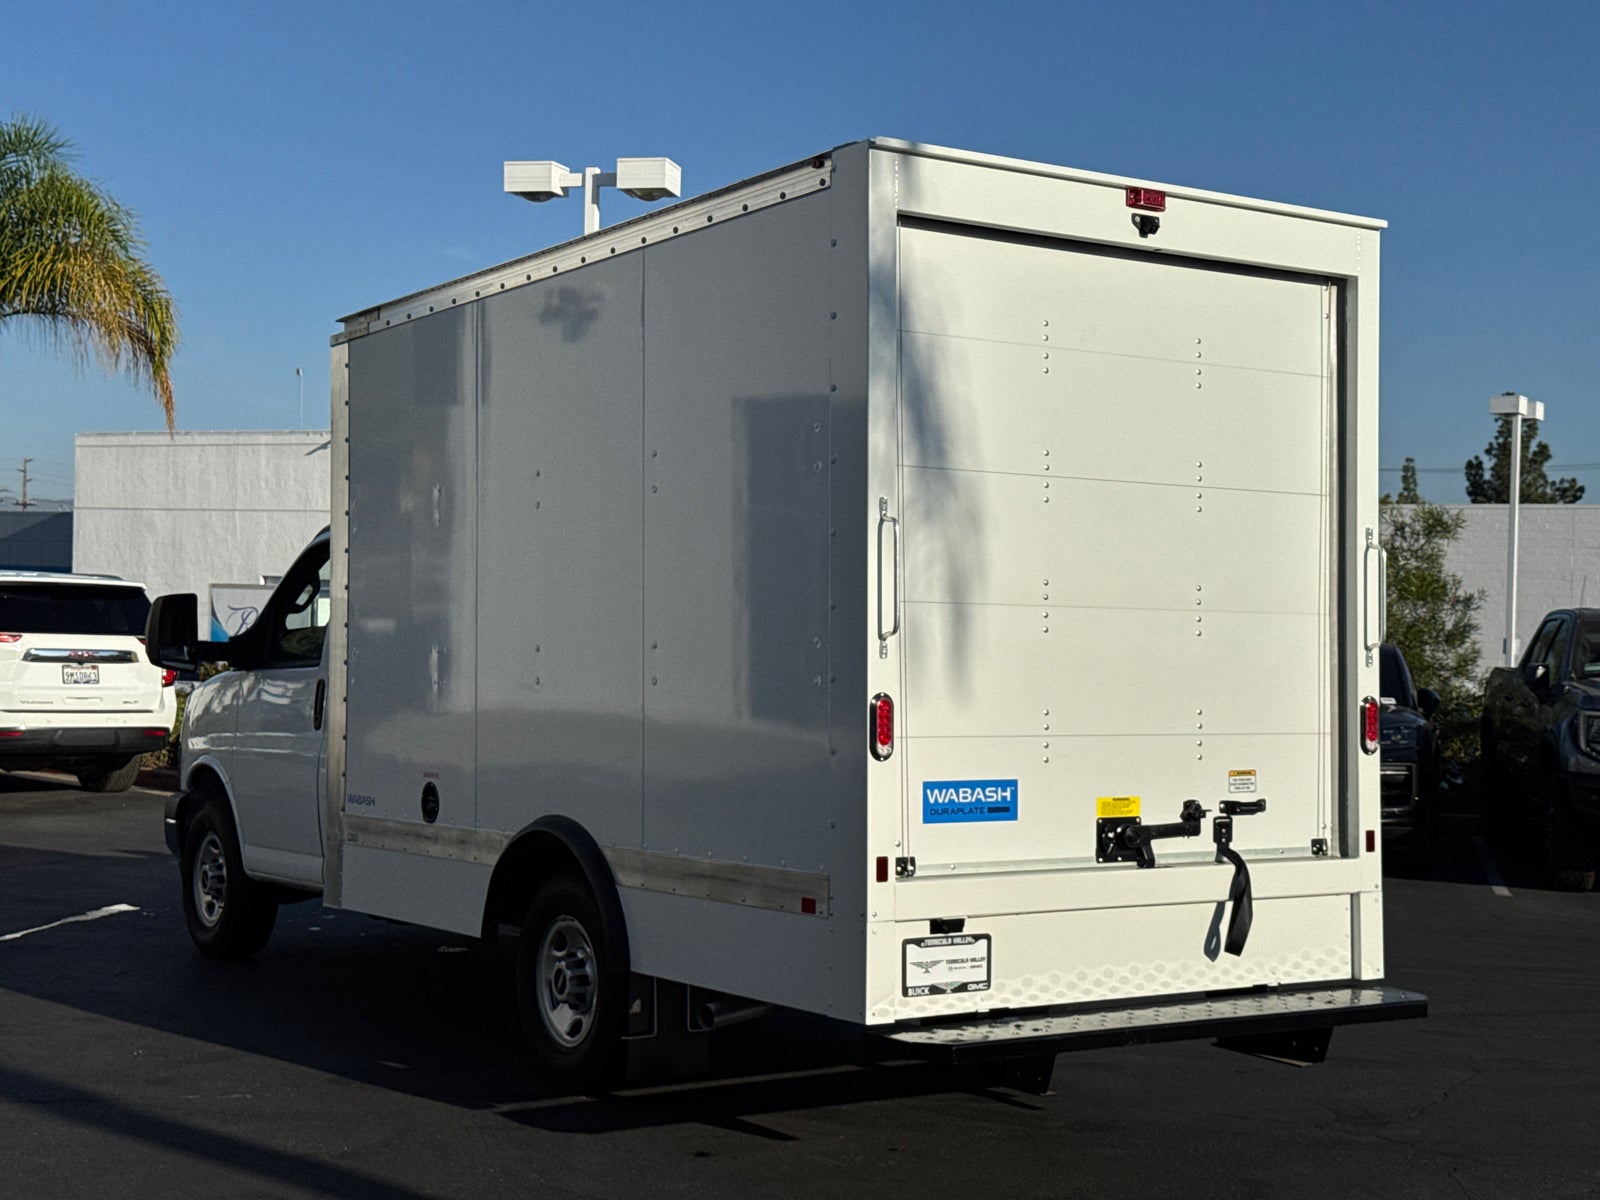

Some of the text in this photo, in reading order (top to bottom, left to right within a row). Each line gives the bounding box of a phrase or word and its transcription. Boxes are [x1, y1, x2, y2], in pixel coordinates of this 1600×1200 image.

[347, 794, 376, 806] WABASH
[926, 787, 1011, 804] WABASH
[930, 807, 985, 816] DURAPLATE
[907, 986, 930, 996] BUICK
[967, 983, 988, 991] GMC
